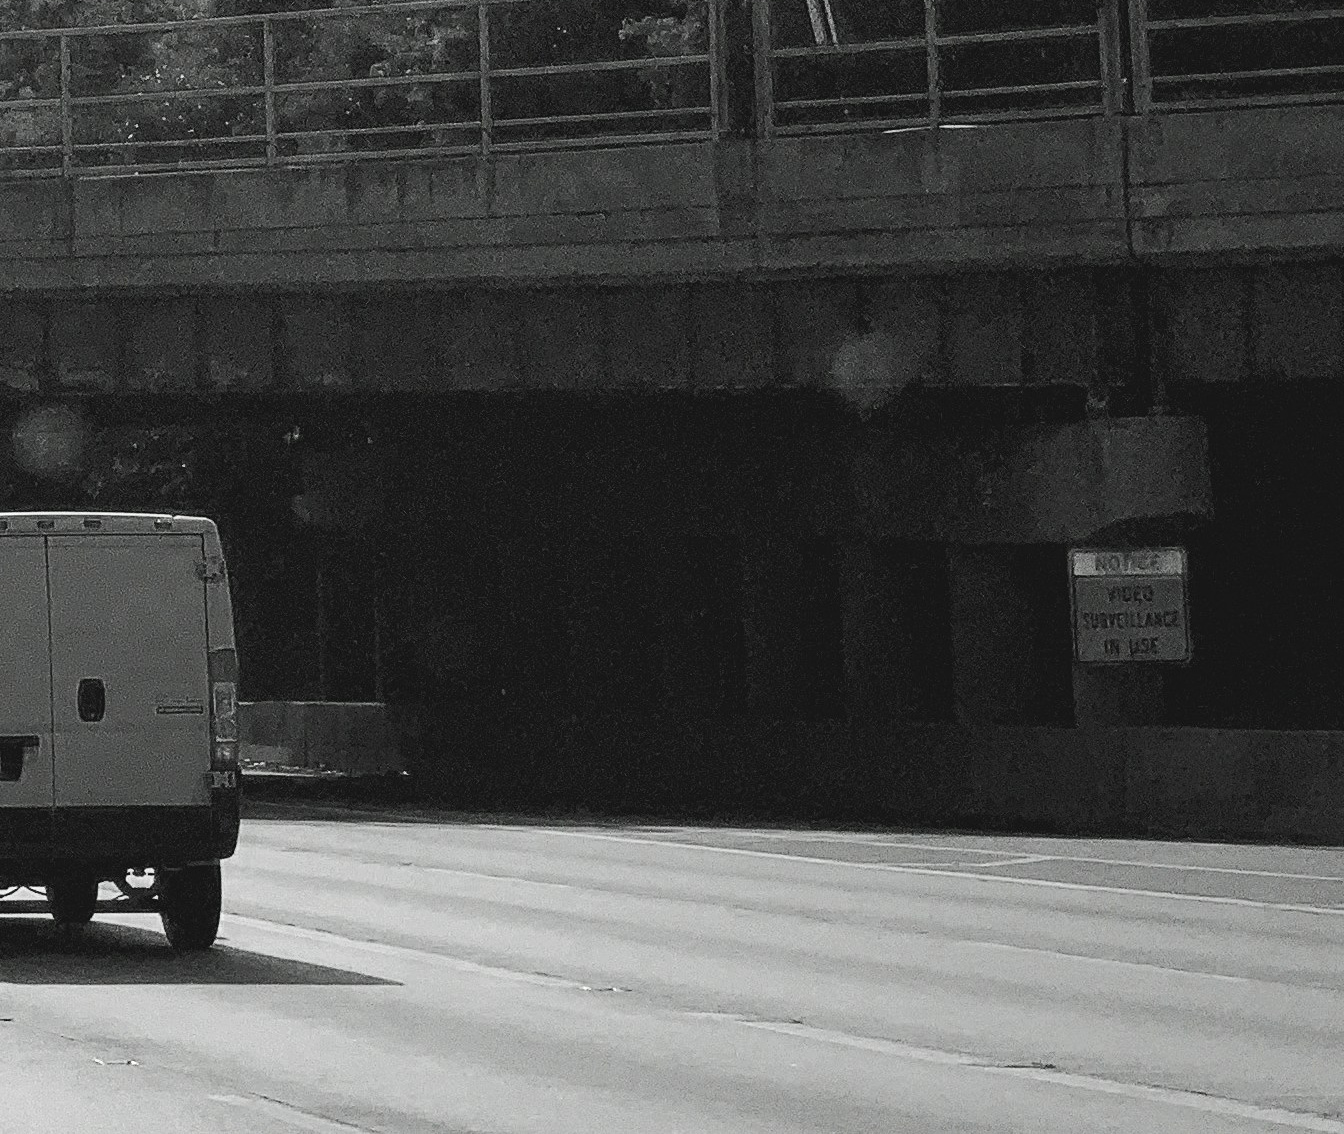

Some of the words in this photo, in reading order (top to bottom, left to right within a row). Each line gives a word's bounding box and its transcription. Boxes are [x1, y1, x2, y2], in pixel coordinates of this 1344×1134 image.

[1095, 551, 1160, 571] NOTICE
[1105, 585, 1154, 602] VIDEO
[1083, 611, 1180, 629] SURVEILLANCE
[1104, 638, 1120, 654] IN
[1128, 637, 1159, 655] USE
